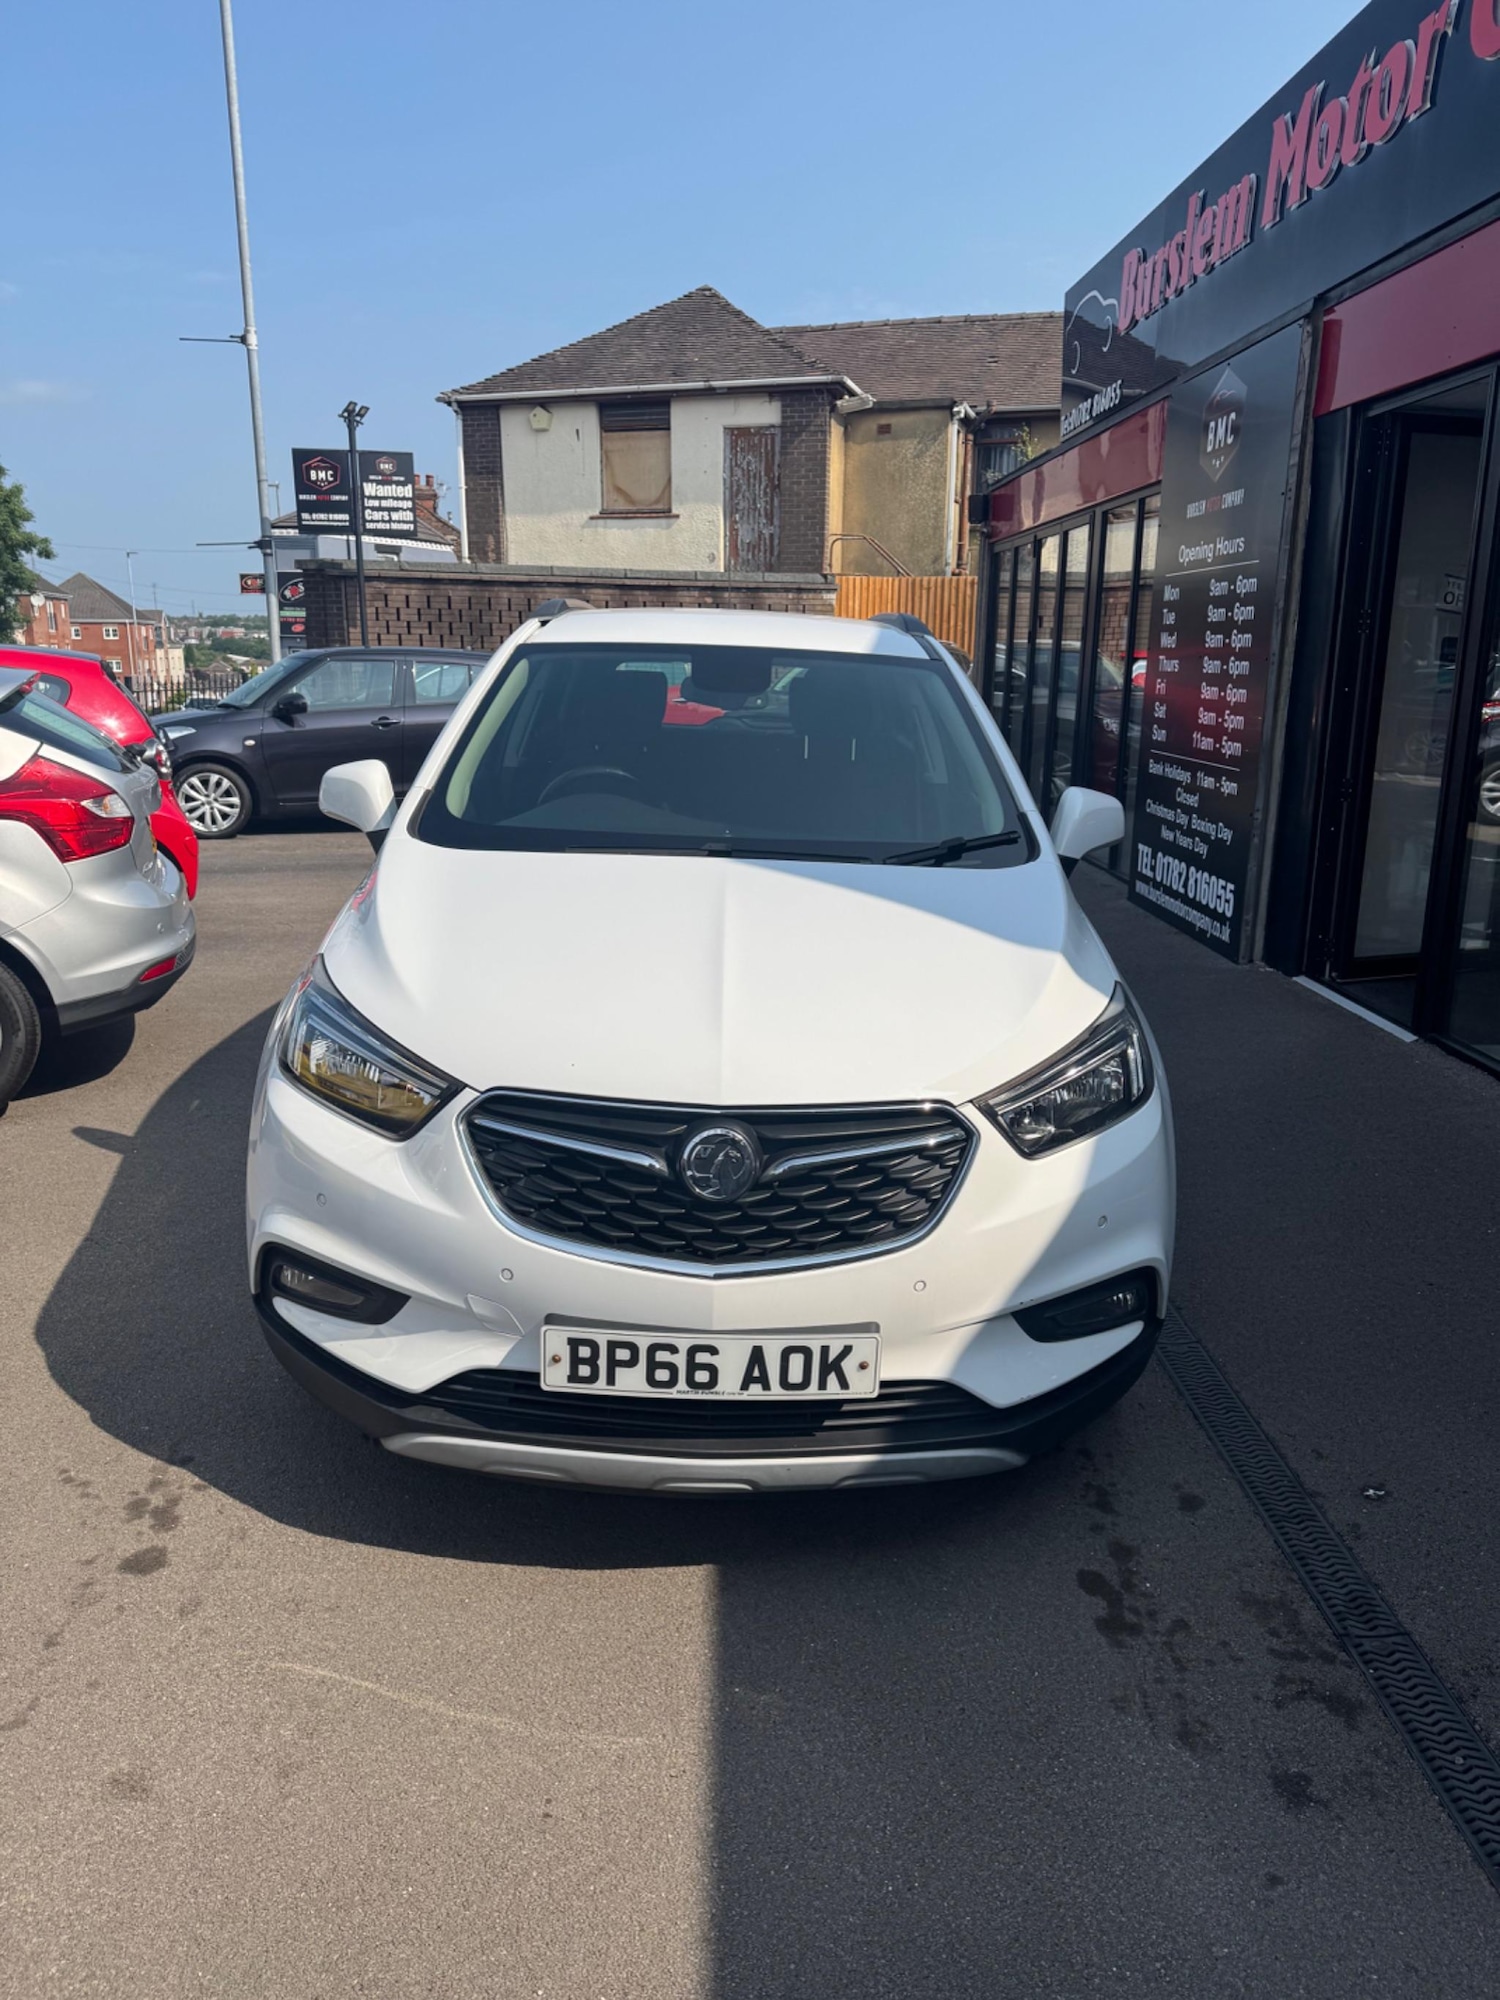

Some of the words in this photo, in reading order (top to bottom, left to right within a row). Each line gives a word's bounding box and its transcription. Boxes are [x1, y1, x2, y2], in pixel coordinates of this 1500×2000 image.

[1118, 173, 1257, 335] Burslem
[1261, 0, 1459, 230] Motor
[1206, 411, 1236, 453] BMC
[310, 470, 334, 481] BMC
[363, 482, 412, 498] Wanted
[364, 498, 380, 507] Low
[380, 498, 413, 509] mileage
[364, 508, 390, 521] Cars
[390, 509, 414, 521] with
[365, 521, 390, 530] service
[390, 521, 415, 532] history
[1179, 541, 1214, 567] Opening
[1215, 536, 1245, 557] Hours
[1163, 584, 1180, 601] Mon
[1209, 578, 1229, 596] 9am
[1236, 574, 1258, 598] 6pm
[1162, 608, 1176, 625] Tue
[1207, 604, 1226, 622] 9am
[1233, 602, 1255, 625] 6pm
[1160, 631, 1178, 648] Wed
[1205, 630, 1224, 648] 9am
[1231, 629, 1253, 652] 6pm
[1159, 655, 1179, 672] Thurs
[1202, 656, 1222, 674] 9am
[1228, 656, 1250, 679] 6pm
[1155, 679, 1167, 695] Fri
[1200, 681, 1220, 700] 9am
[1226, 683, 1248, 707] 6pm
[1154, 701, 1167, 719] Sat
[1198, 706, 1217, 726] 9am
[1223, 710, 1245, 733] 5pm
[1152, 724, 1168, 742] Sun
[1192, 731, 1214, 751] 11am
[1221, 736, 1242, 759] 5pm
[1148, 759, 1164, 776] Bank
[1164, 761, 1192, 786] Holidays
[1196, 770, 1215, 790] 11am
[1220, 776, 1238, 797] 5pm
[1176, 787, 1200, 808] Closed
[1145, 798, 1175, 822] Christmas
[1176, 808, 1190, 830] Day
[1191, 813, 1216, 840] Boxing
[1217, 822, 1233, 846] Day
[1160, 824, 1175, 842] New
[1176, 829, 1194, 850] Years
[1194, 837, 1209, 860] Day
[1155, 851, 1187, 894] 01782
[1187, 865, 1235, 918] 816055
[566, 1337, 720, 1390] BP66
[739, 1344, 853, 1391] AOK
